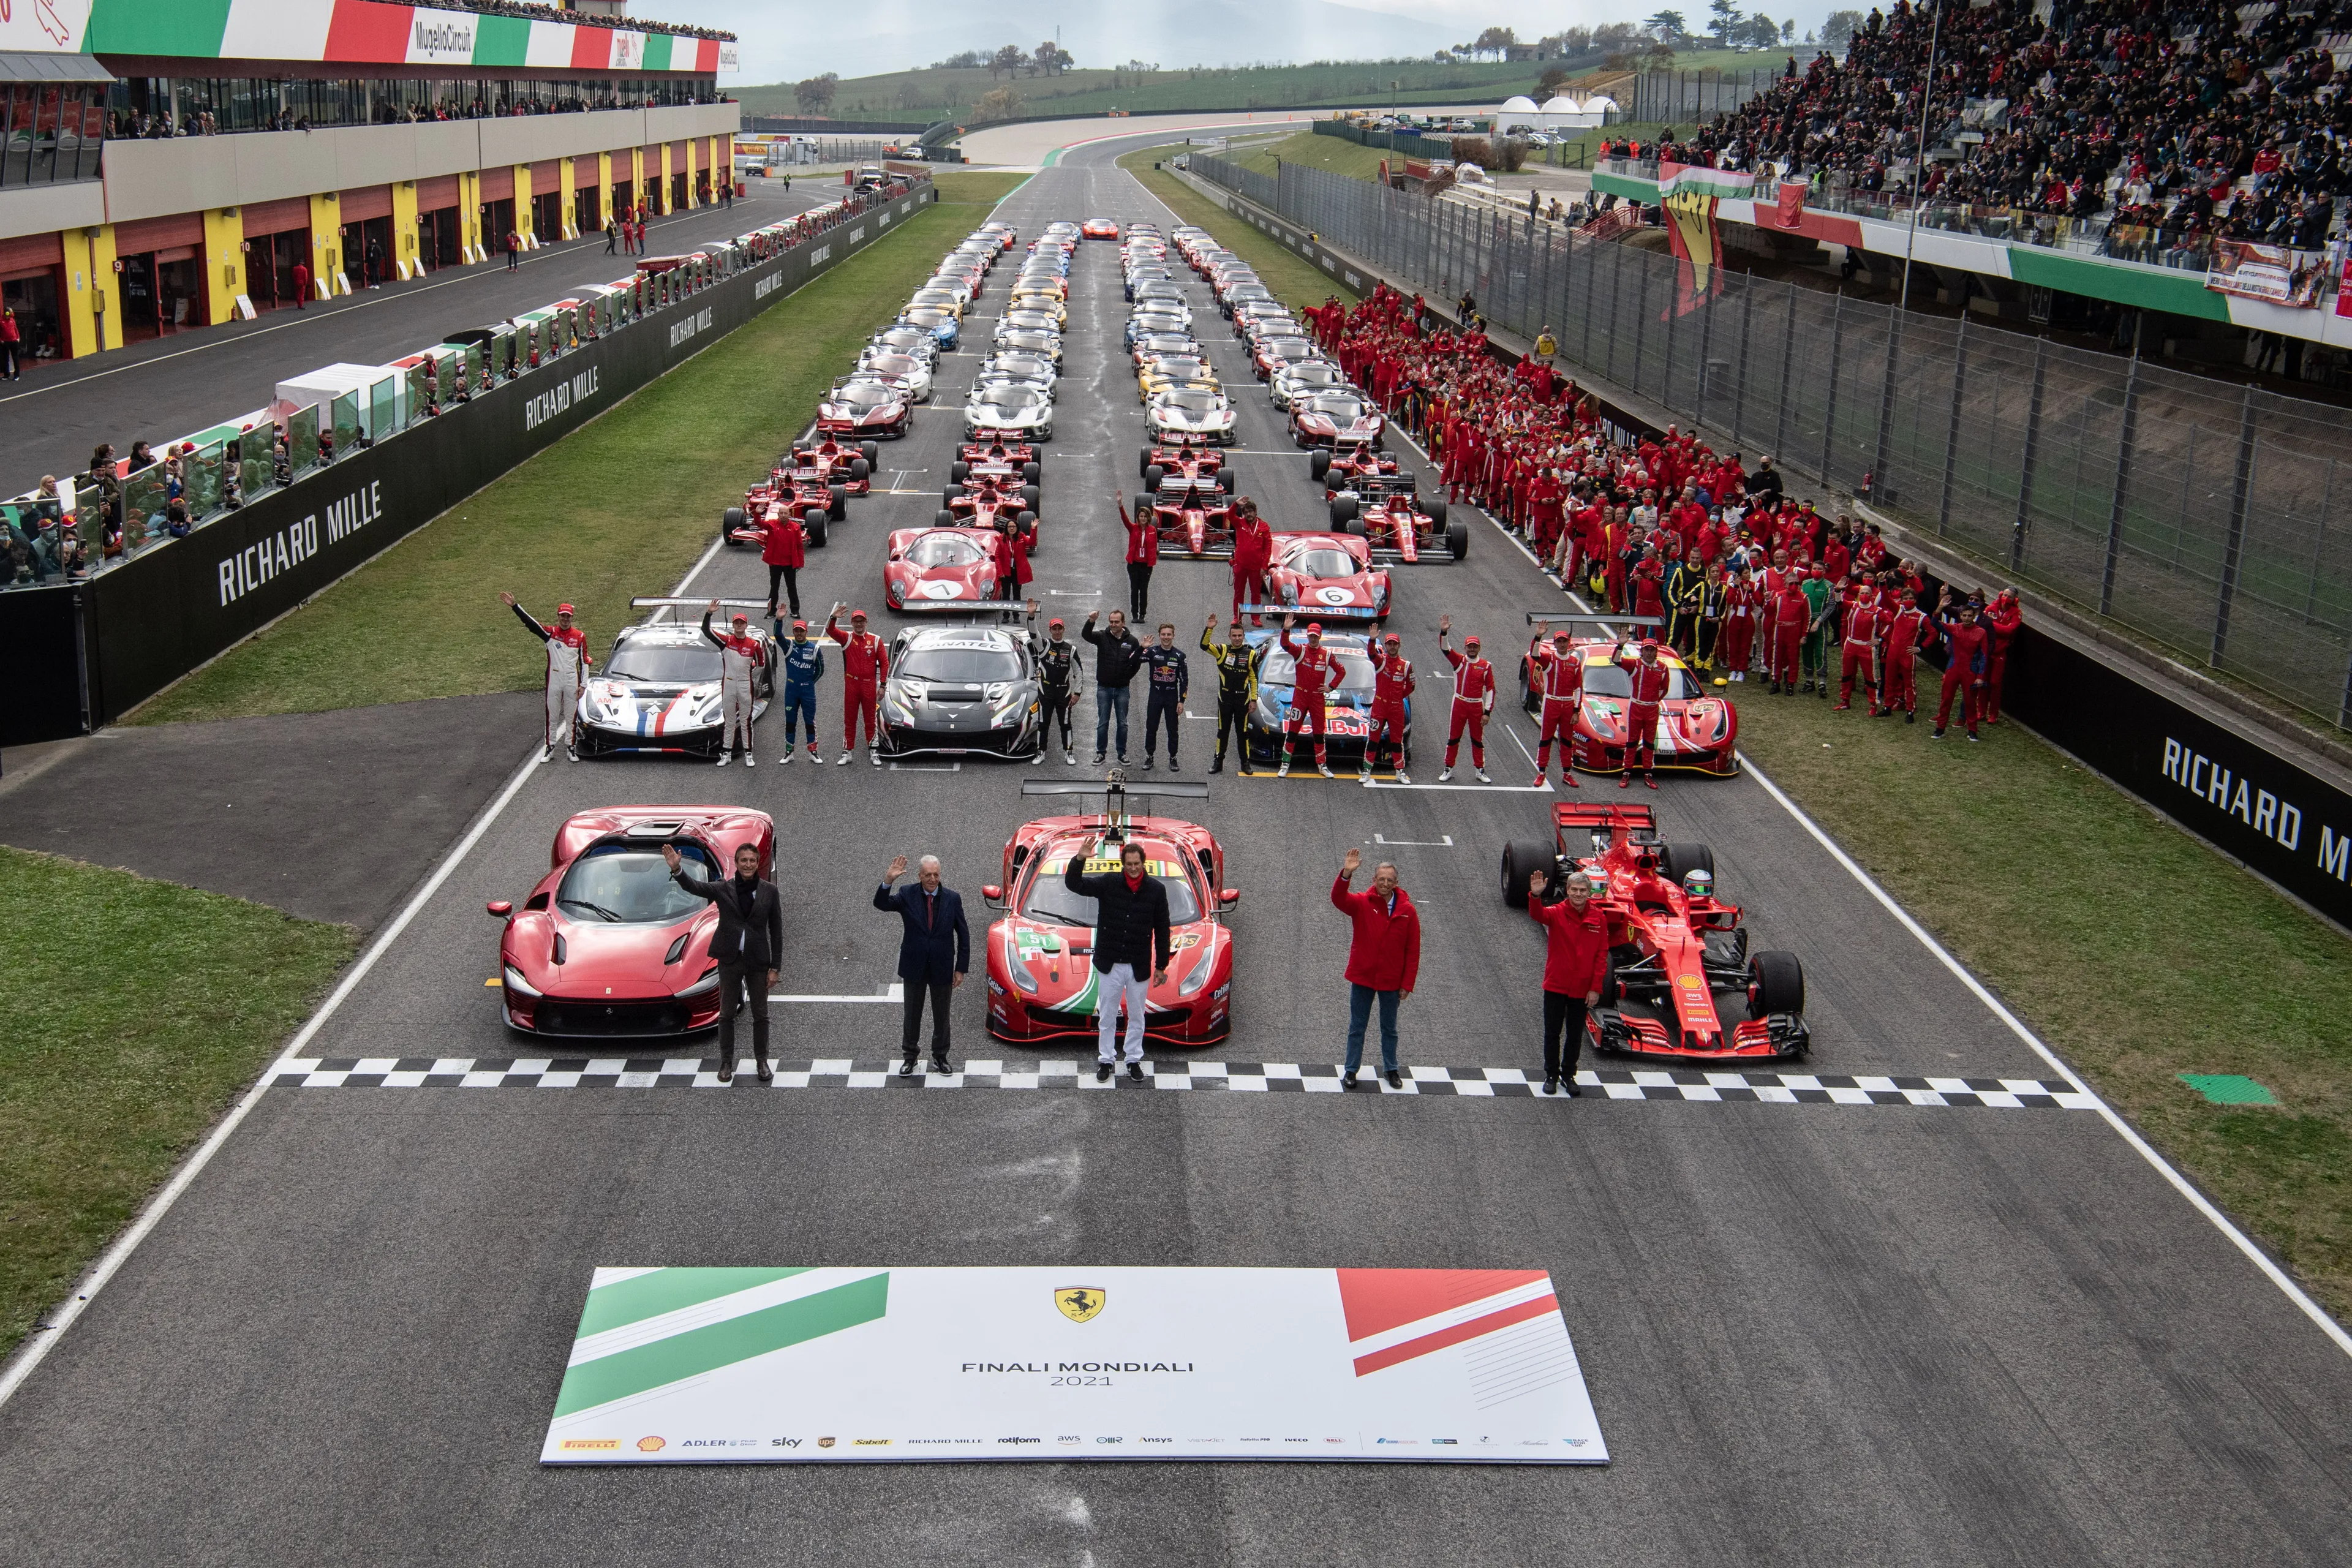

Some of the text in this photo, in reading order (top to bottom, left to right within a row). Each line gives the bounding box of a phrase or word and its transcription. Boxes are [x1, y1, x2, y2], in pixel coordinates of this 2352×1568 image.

[416, 21, 471, 57] MugelloCircuit
[416, 215, 423, 224] 12
[339, 227, 347, 236] 11
[240, 242, 250, 252] 10
[114, 261, 123, 271] 9
[756, 270, 782, 300] RICHARD MILLE
[671, 306, 712, 348] RICHARD MILLE
[526, 366, 598, 431] RICHARD MILLE
[1401, 530, 1414, 538] 27
[219, 480, 382, 607] RICHARD MILLE
[1325, 590, 1343, 601] 6
[1291, 709, 1300, 718] 51
[1370, 719, 1378, 730] 52
[2162, 736, 2301, 851] RICHARD
[1030, 935, 1047, 946] 51
[987, 978, 1004, 996] Cetilar
[1213, 980, 1231, 1000] Cetilar
[962, 1363, 1194, 1373] FINALI MONDIALI
[1050, 1376, 1114, 1386] 2021
[772, 1437, 802, 1449] sky
[819, 1438, 835, 1447] ups
[998, 1436, 1041, 1446] rotiform
